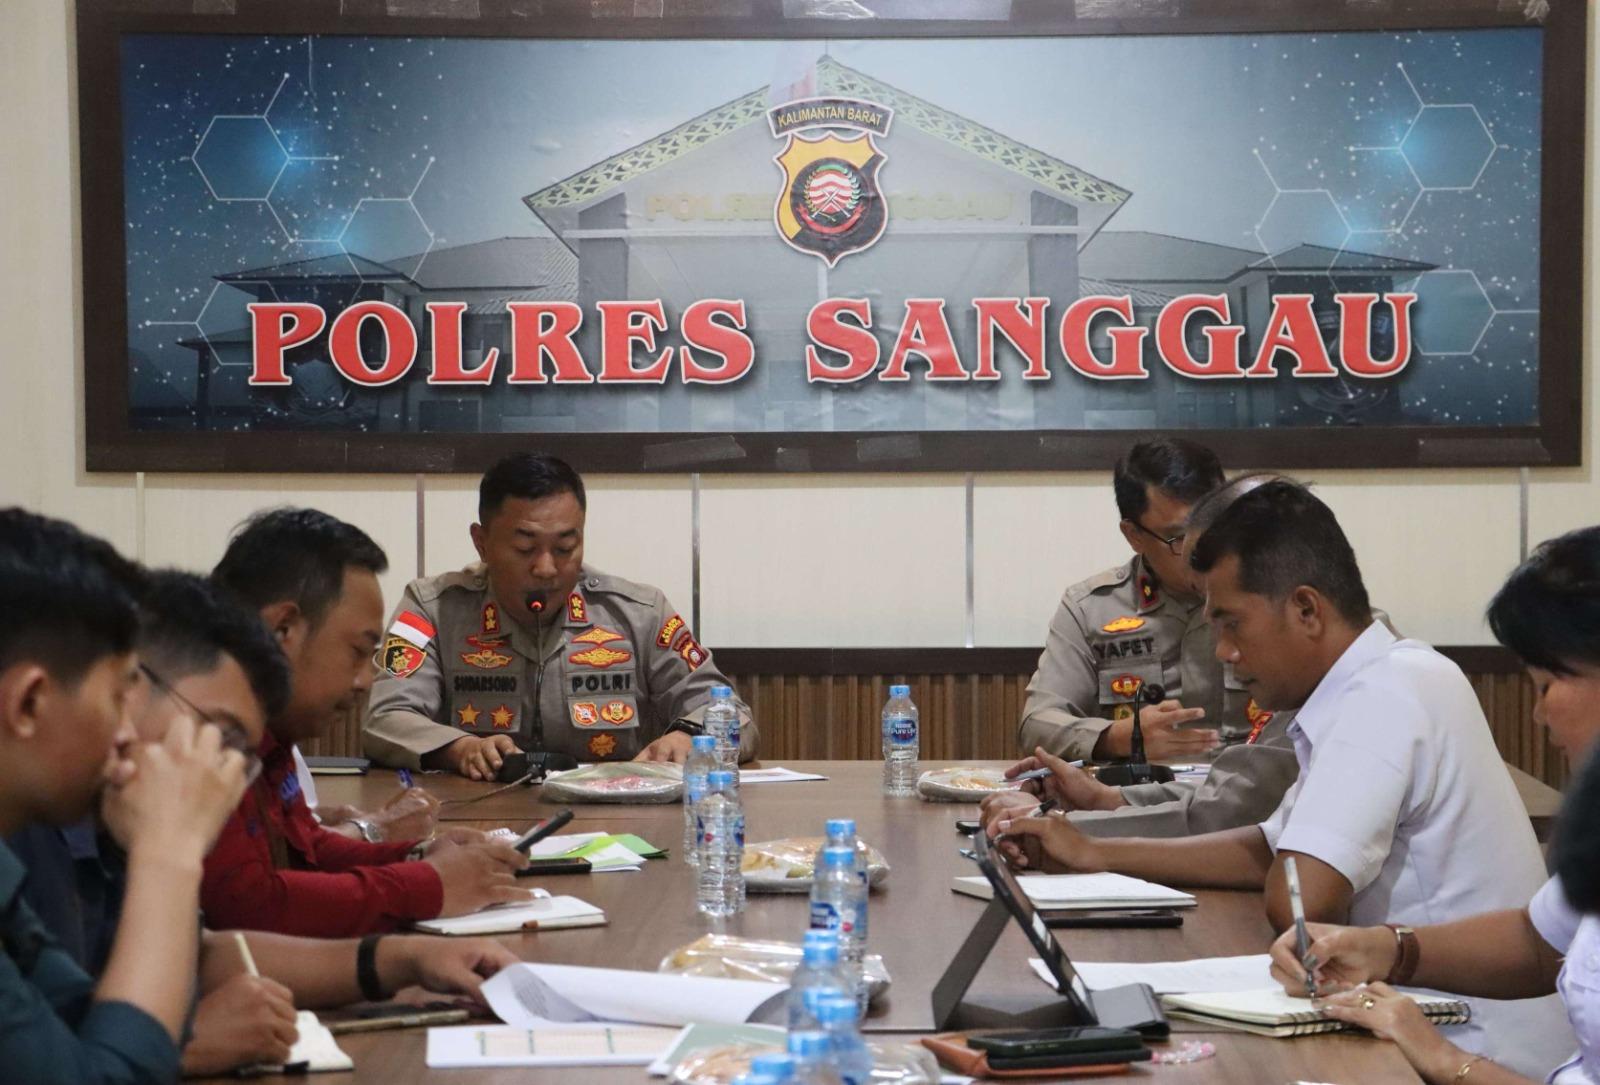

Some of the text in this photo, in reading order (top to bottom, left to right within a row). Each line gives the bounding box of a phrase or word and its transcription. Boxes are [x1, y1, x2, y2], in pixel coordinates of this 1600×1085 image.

[777, 106, 882, 127] KALIMANTAN BARAT
[247, 293, 1418, 387] POLRES SANGGAU
[1093, 637, 1155, 659] YAFET
[571, 673, 631, 693] POLRI
